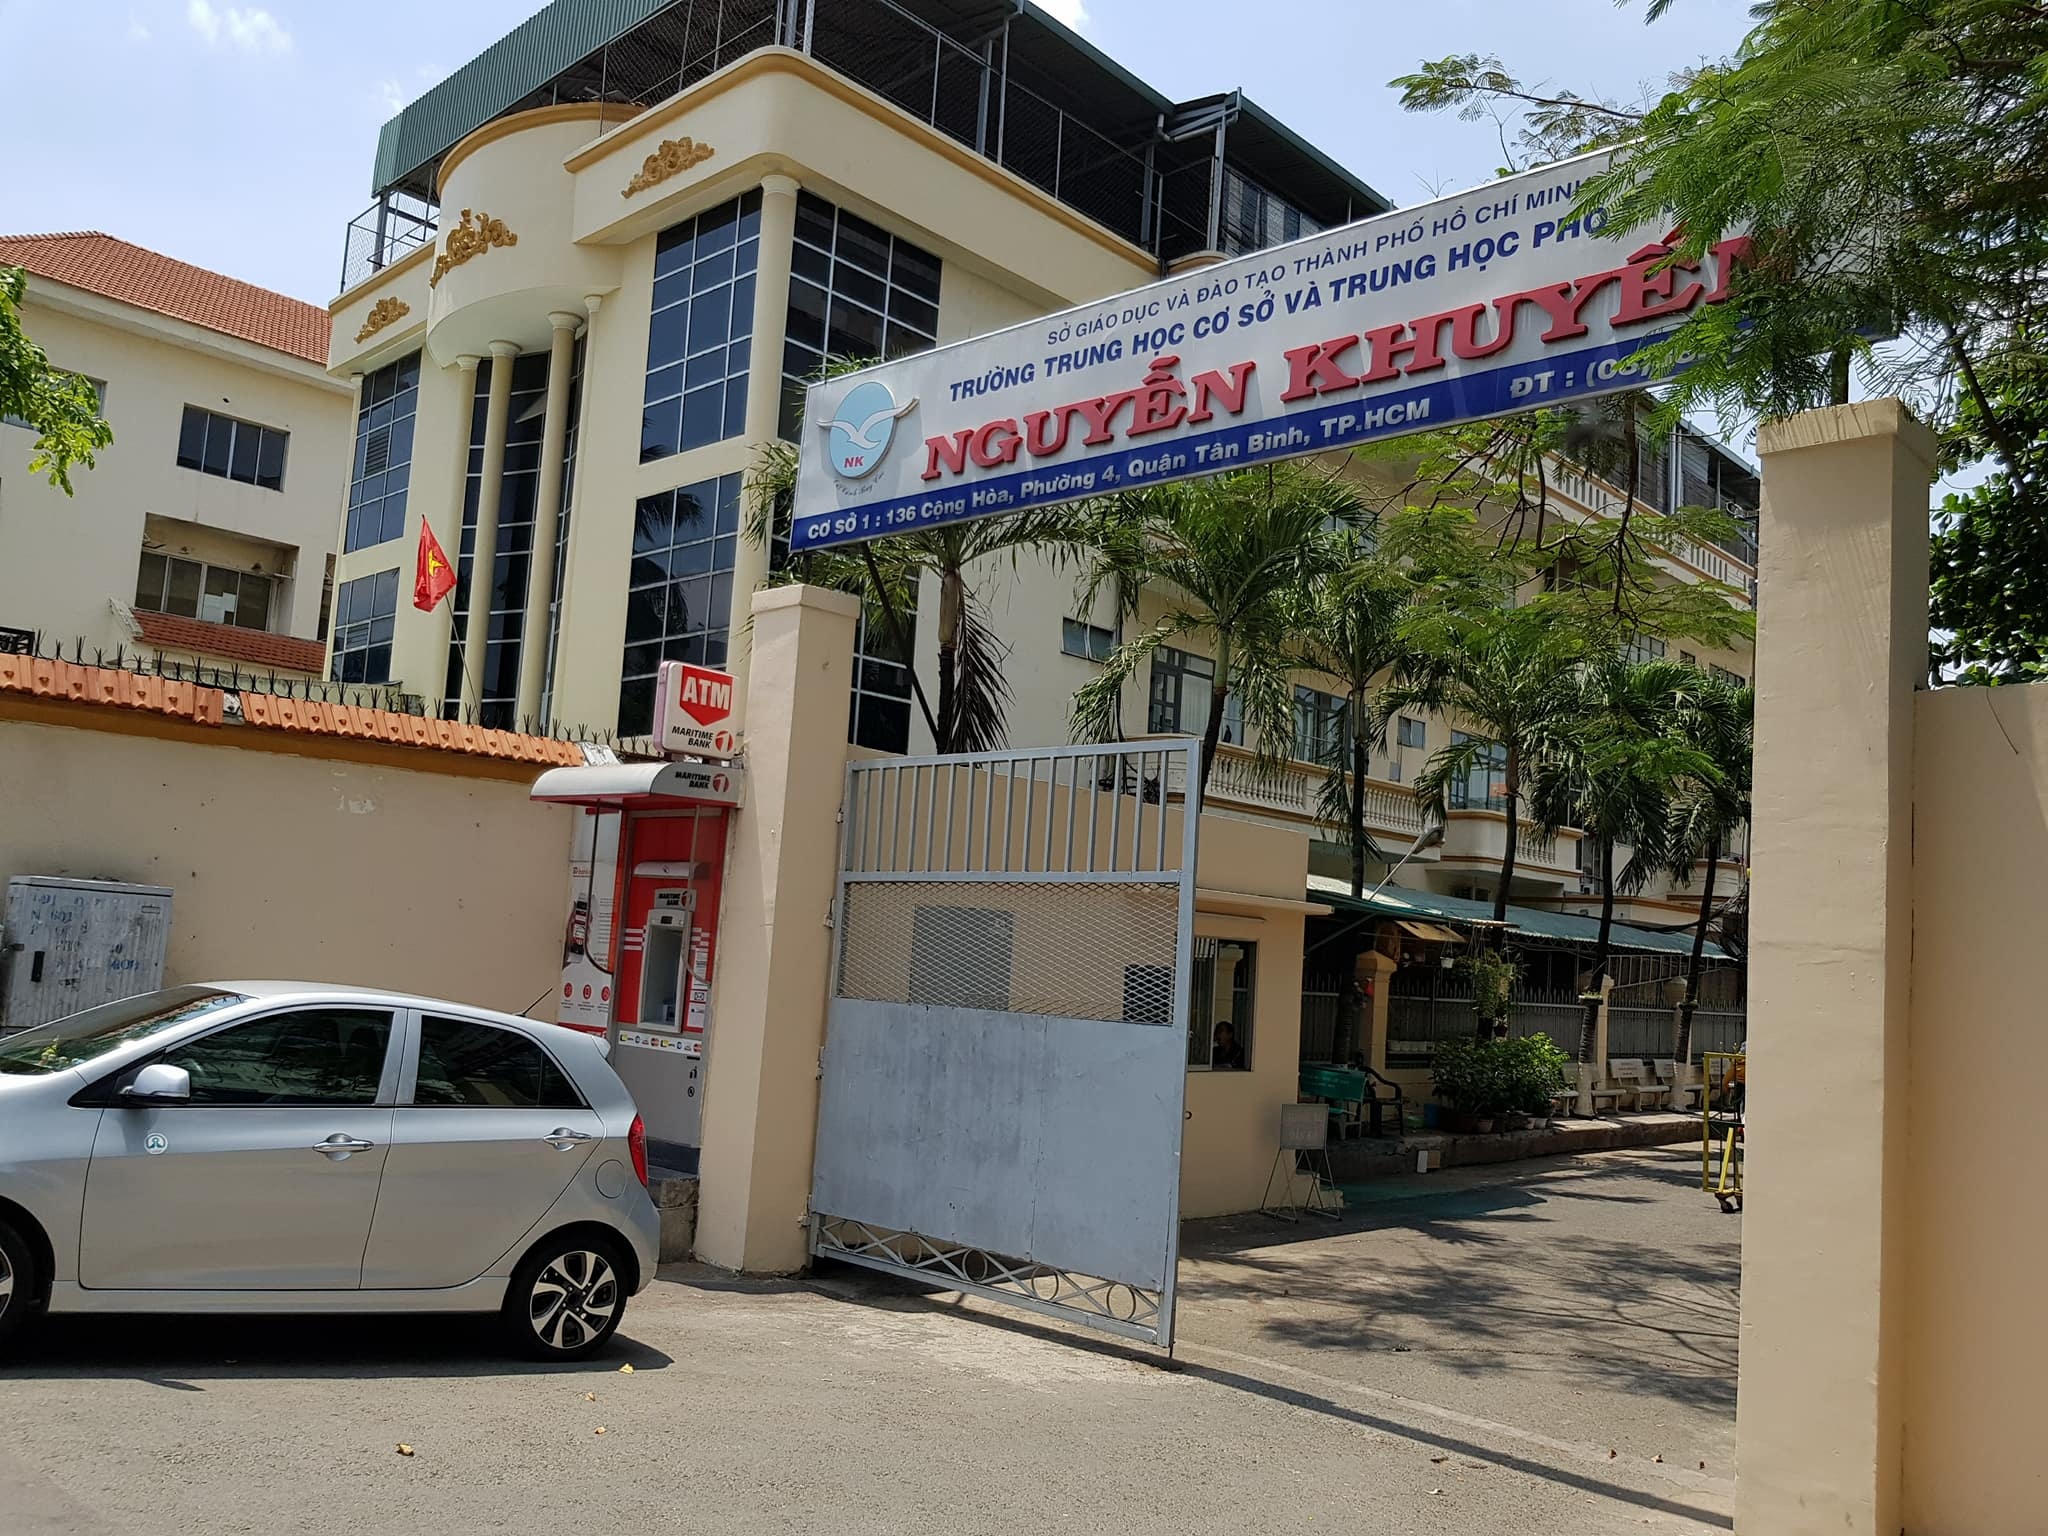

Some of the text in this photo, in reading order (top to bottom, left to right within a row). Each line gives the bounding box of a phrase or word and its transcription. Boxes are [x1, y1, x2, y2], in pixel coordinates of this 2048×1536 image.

[1047, 321, 1071, 345] SỞ
[1076, 313, 1118, 338] GIÁO
[1122, 302, 1160, 325] DỤC
[1167, 288, 1190, 312] VÀ
[1197, 278, 1238, 304] ĐÀO
[1245, 265, 1286, 290] TẠO
[1294, 241, 1367, 276] THÀNH
[1376, 217, 1425, 253] PHỐ
[1432, 205, 1467, 237] HỒ
[1475, 196, 1518, 224] CHÍ
[950, 363, 1035, 402] TRƯỜNG
[1044, 339, 1123, 378] TRUNG
[1132, 323, 1185, 356] HỌC
[1193, 306, 1230, 339] CƠ
[1238, 289, 1275, 328] SỞ
[1284, 280, 1322, 314] VÀ
[1328, 254, 1436, 303] TRUNG
[1448, 230, 1519, 272] HỌC
[920, 355, 1257, 481] NGUYỄN
[808, 519, 831, 540] CƠ
[834, 511, 857, 535] SỞ
[862, 516, 870, 530] 1
[887, 506, 916, 526] 136
[921, 499, 966, 520] Cộng
[972, 488, 1014, 508] Hòa,
[1020, 468, 1096, 498] Phường
[1101, 465, 1121, 484] 4,
[1128, 452, 1186, 478] Quận
[1195, 442, 1239, 464] Tân
[1247, 426, 1311, 454] Bình,
[1319, 398, 1431, 440] TP.HCM
[1510, 370, 1555, 399] ĐT
[844, 456, 865, 469] NK
[682, 676, 731, 711] ATM
[672, 725, 714, 741] MARITIME
[687, 737, 711, 749] BANK
[674, 771, 711, 782] MARITIME
[688, 780, 710, 790] BANK
